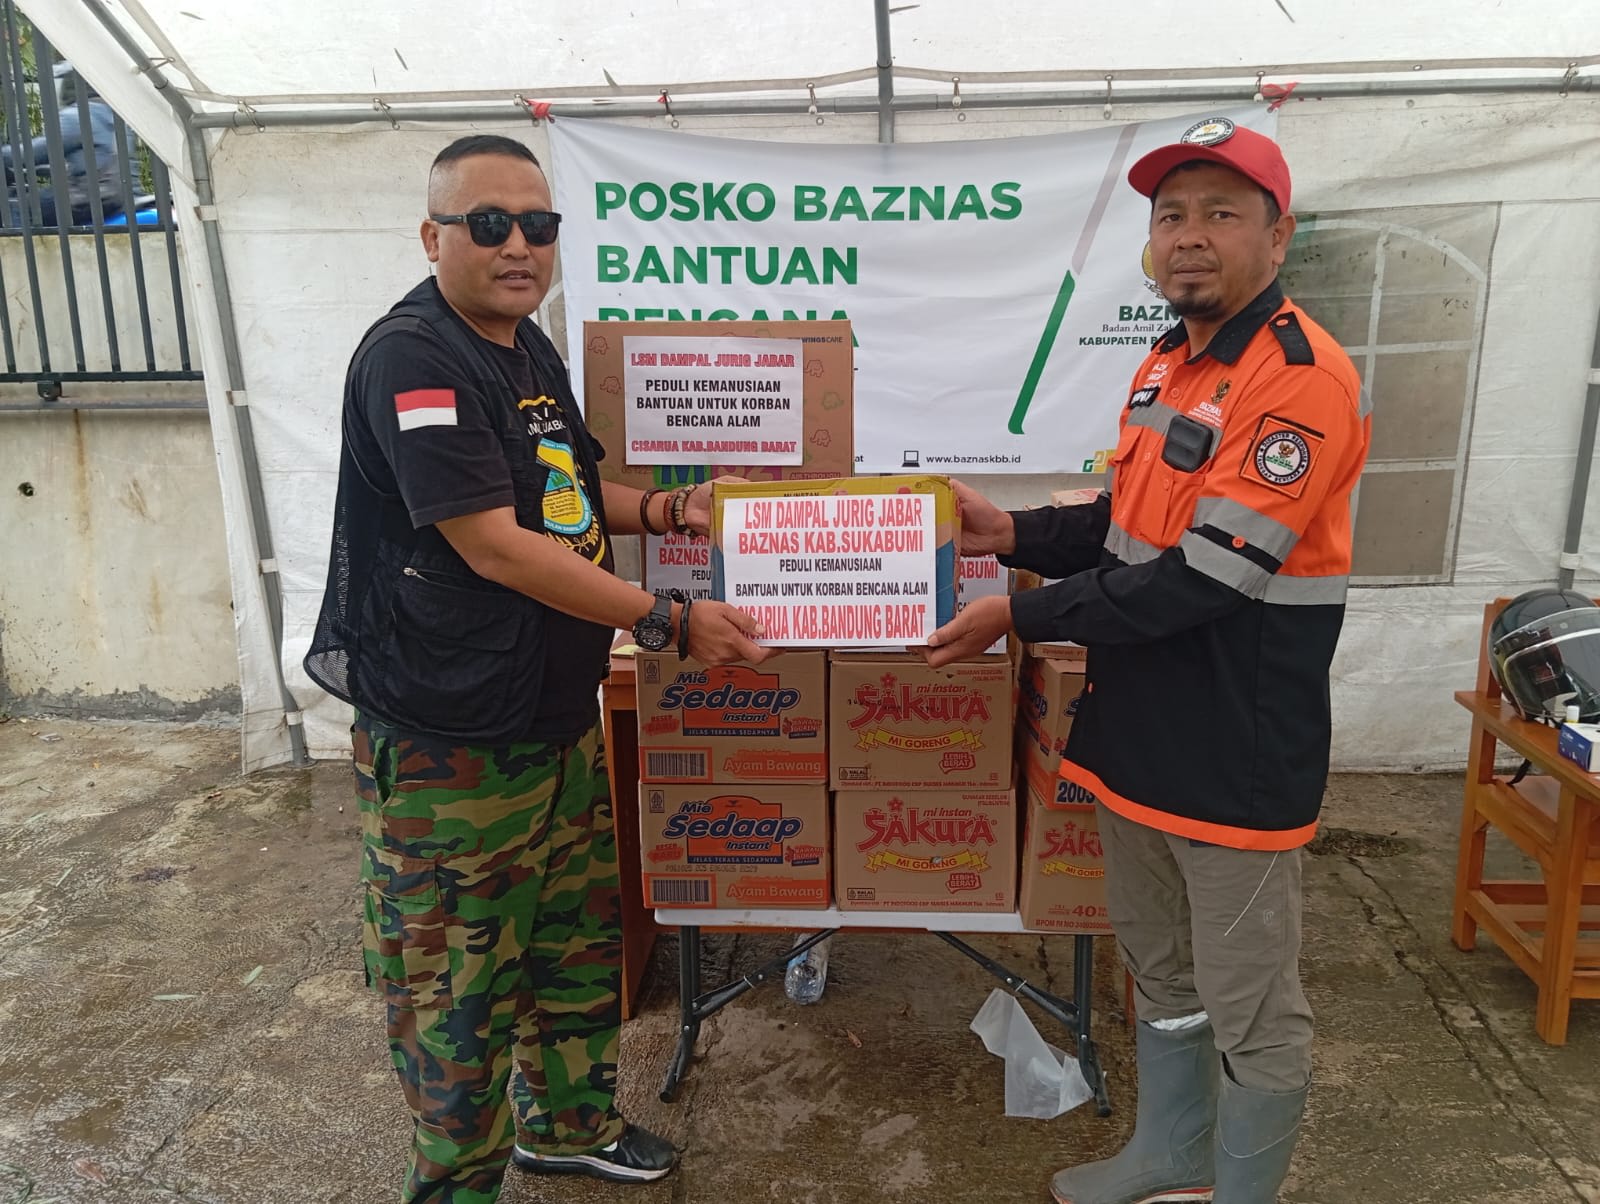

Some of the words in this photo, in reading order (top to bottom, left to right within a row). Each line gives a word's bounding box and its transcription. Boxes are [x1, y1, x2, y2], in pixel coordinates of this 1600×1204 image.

[595, 181, 776, 222] POSKO
[794, 181, 1023, 222] BAZNAS
[597, 245, 858, 285] BANTUAN
[1102, 324, 1131, 333] Badan
[1132, 324, 1155, 333] Amil
[1079, 336, 1147, 346] KABUPATEN
[631, 353, 658, 367] LSM
[660, 353, 712, 367] DAMPAL
[713, 353, 751, 367] JURIG
[754, 353, 795, 367] JABAR
[645, 379, 689, 393] PEDULI
[693, 379, 781, 393] KEMANUSIAAN
[636, 397, 693, 410] BANTUAN
[697, 397, 737, 410] UNTUK
[741, 397, 791, 410] KORBAN
[666, 415, 723, 428] BENCANA
[727, 415, 761, 428] ALAM
[631, 440, 680, 452] CISARUA
[682, 441, 758, 453] KAB.BANDUNG
[761, 441, 797, 453] BARAT
[925, 453, 1021, 465] www.baznaskbb.id
[744, 501, 771, 529] LSM
[776, 501, 830, 529] DAMPAL
[832, 500, 874, 528] JURIG
[878, 499, 923, 528] JABAR
[738, 531, 800, 555] BAZNAS
[804, 530, 923, 554] KAB.SUKABUMI
[659, 547, 708, 565] BAZNAS
[779, 558, 812, 572] PEDULI
[814, 558, 882, 572] KEMANUSIAAN
[735, 583, 778, 597] BANTUAN
[781, 583, 813, 597] UNTUK
[815, 582, 854, 596] KORBAN
[856, 582, 901, 596] BENCANA
[903, 582, 928, 596] ALAM
[792, 604, 882, 640] KAB.BANDUNG
[885, 604, 926, 639] BARAT
[676, 671, 709, 685] Mie
[916, 684, 932, 694] mi
[933, 684, 967, 694] instan
[658, 683, 801, 716] Sedaap
[722, 712, 769, 723] Instant
[888, 736, 901, 747] MI
[904, 736, 951, 748] GORENG
[944, 752, 968, 760] LEBIH
[724, 758, 763, 772] Ayam
[767, 758, 821, 773] Bawang
[943, 759, 970, 767] BERAT
[680, 801, 713, 814] Mie
[923, 808, 937, 817] mi
[938, 808, 972, 817] instan
[662, 812, 803, 843] Sedaap
[725, 841, 772, 851] Instant
[896, 858, 910, 868] MI
[726, 884, 766, 898] Ayam
[769, 885, 824, 899] Bawang
[1072, 905, 1097, 917] 40
